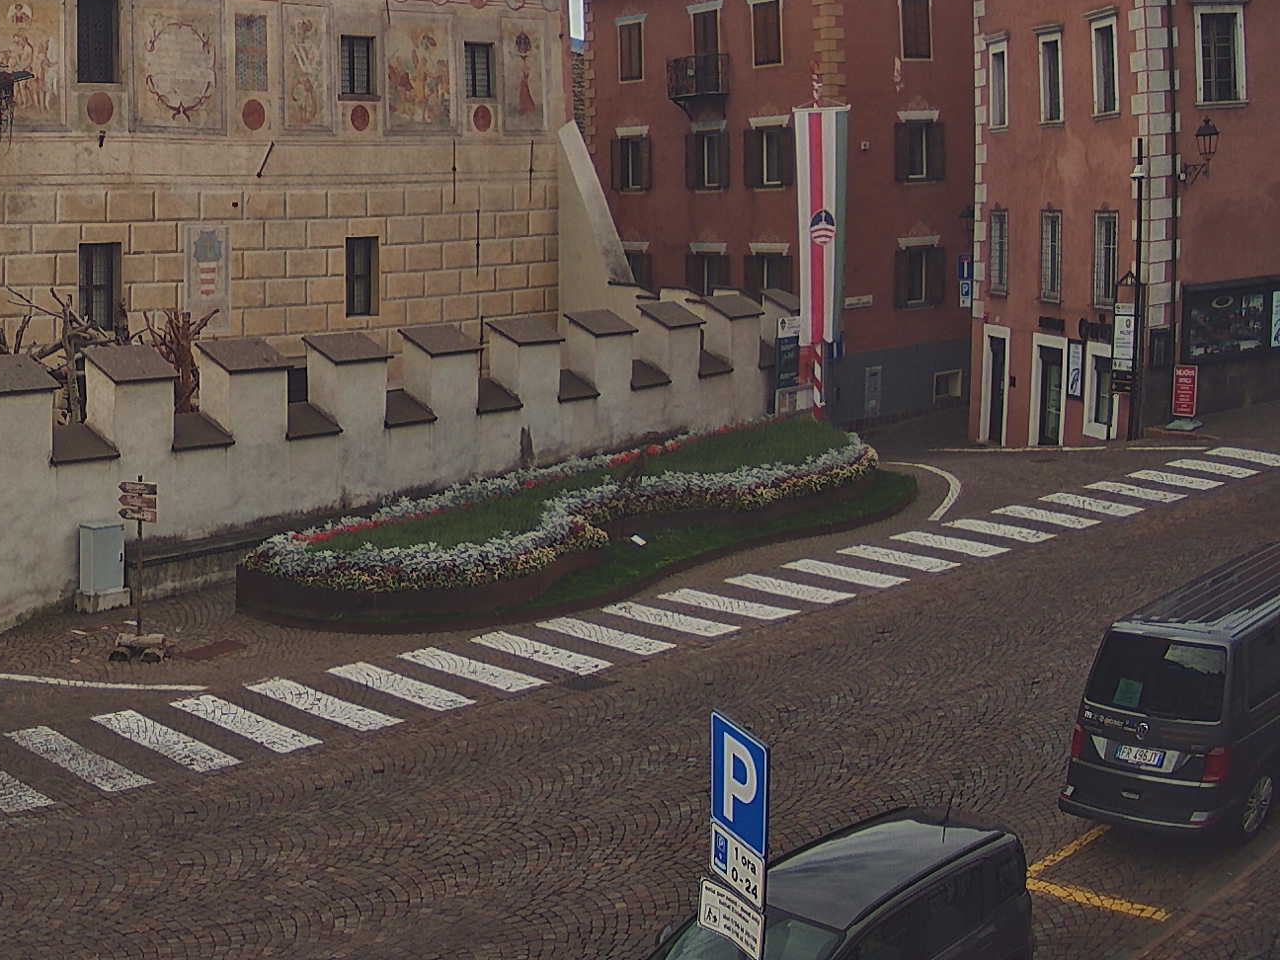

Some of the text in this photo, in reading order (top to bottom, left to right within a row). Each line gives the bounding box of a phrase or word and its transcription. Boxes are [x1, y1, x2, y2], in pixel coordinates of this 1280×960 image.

[723, 731, 757, 823] P
[734, 846, 757, 875] 1 ora
